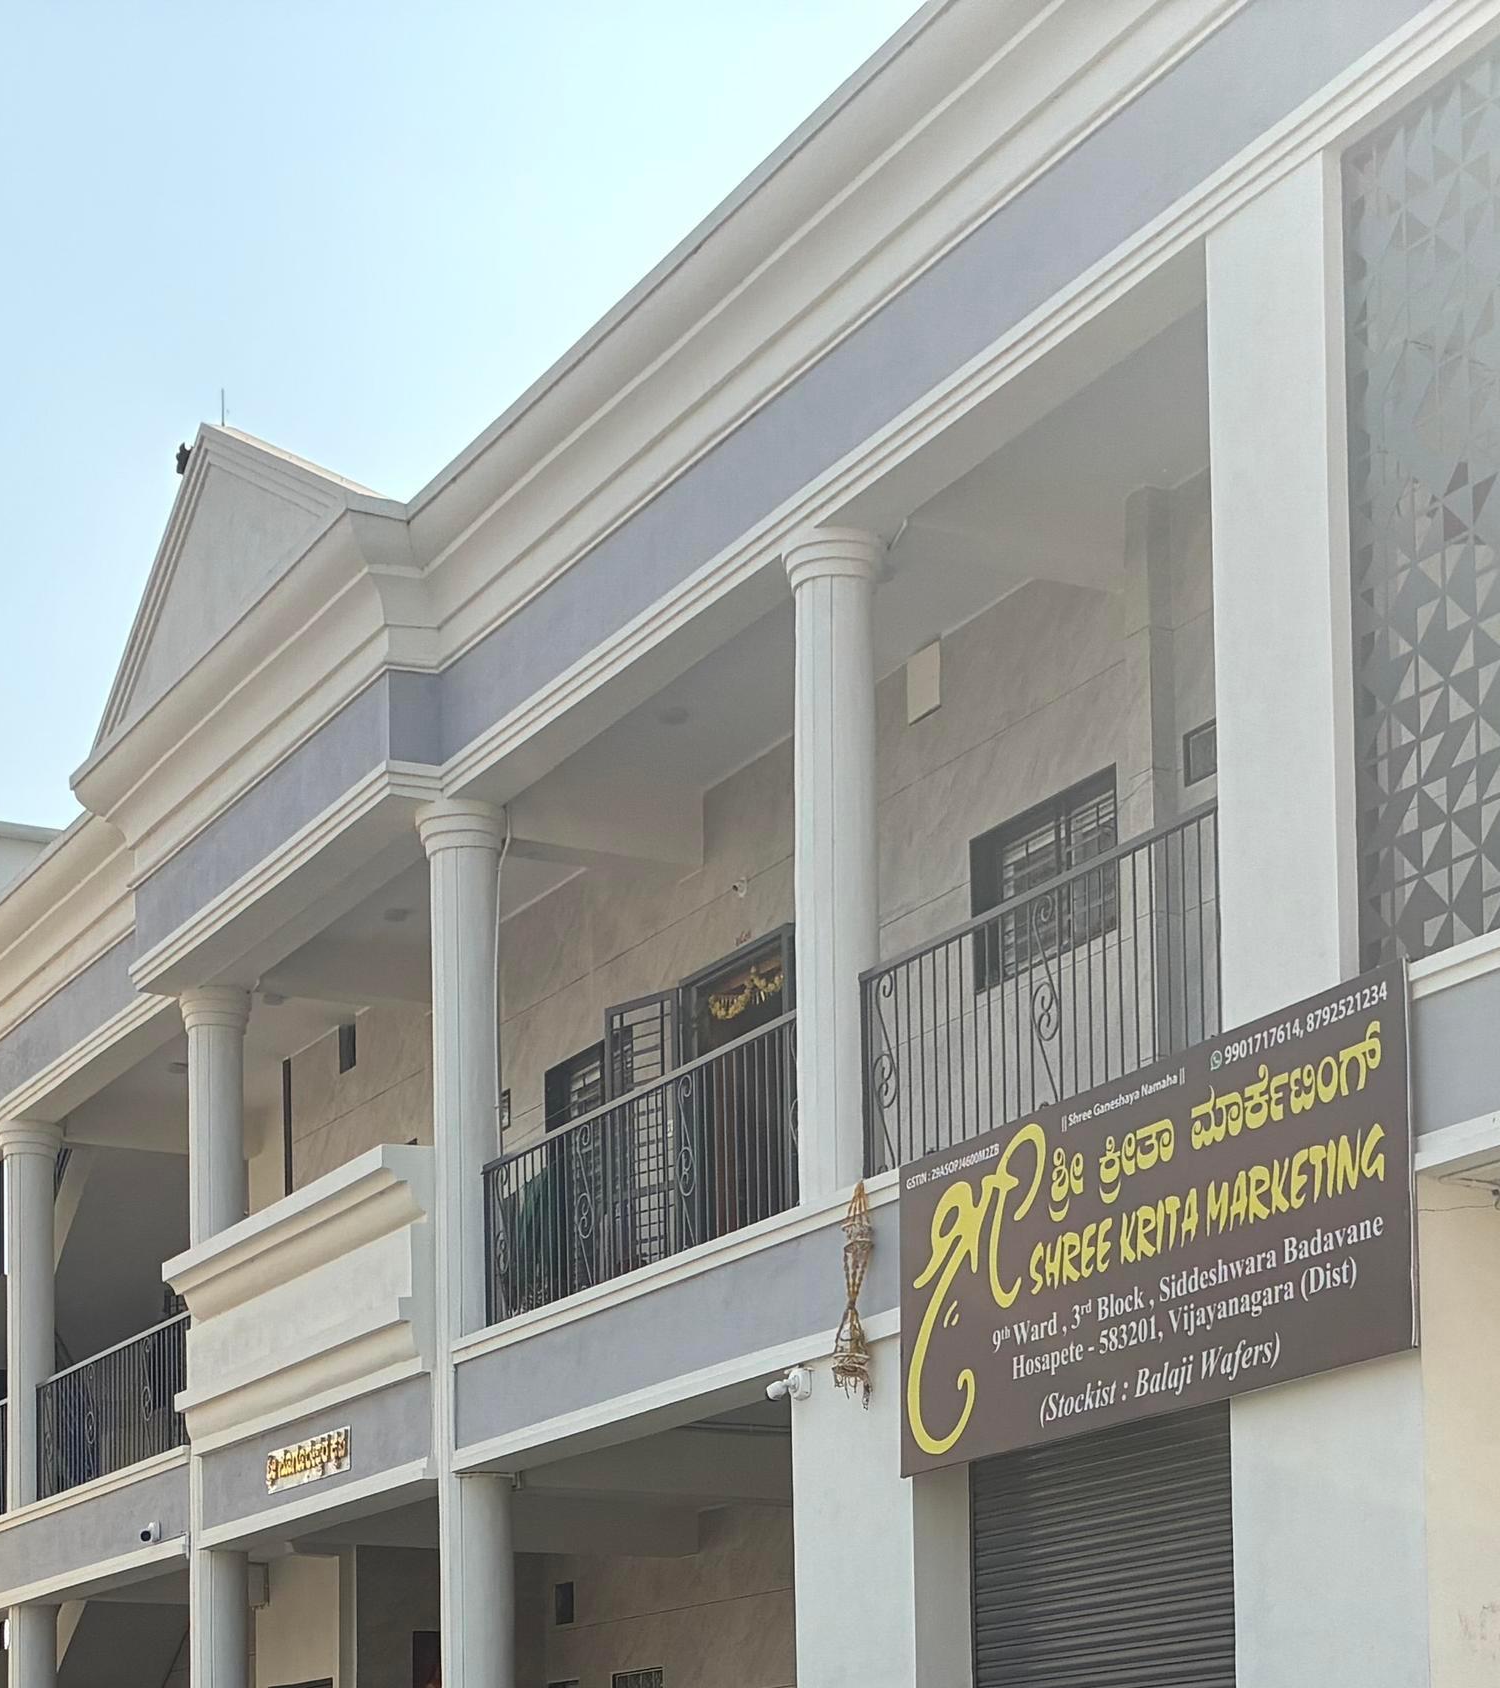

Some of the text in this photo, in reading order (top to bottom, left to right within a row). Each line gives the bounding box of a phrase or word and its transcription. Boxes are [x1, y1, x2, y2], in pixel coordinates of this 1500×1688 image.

[1224, 981, 1388, 1065] 9901717614, 8792521234
[1049, 1020, 1382, 1222] ಶ್ರೀ ಕ್ರೀತಾ ಮಾರ್ಕೆಟಿಂಗ್
[1068, 1107, 1093, 1127] Shree
[1093, 1092, 1140, 1118] Ganeshaya
[1141, 1074, 1178, 1097] Namaha
[1030, 1122, 1386, 1296] SHREE KRITA MARKETING
[992, 1326, 1011, 1353] 9th
[1071, 1299, 1092, 1330] 3rd
[1159, 1245, 1277, 1304] Siddeshwara
[1283, 1215, 1385, 1265] Badavane
[1011, 1343, 1084, 1382] Hosapete
[1099, 1315, 1164, 1356] 583201,
[1167, 1277, 1295, 1336] Vijayanagara
[1300, 1257, 1357, 1303] (Dist)
[1039, 1379, 1117, 1429] (Stockist
[1134, 1357, 1194, 1399] Balaji
[1200, 1332, 1282, 1383] Wafers)
